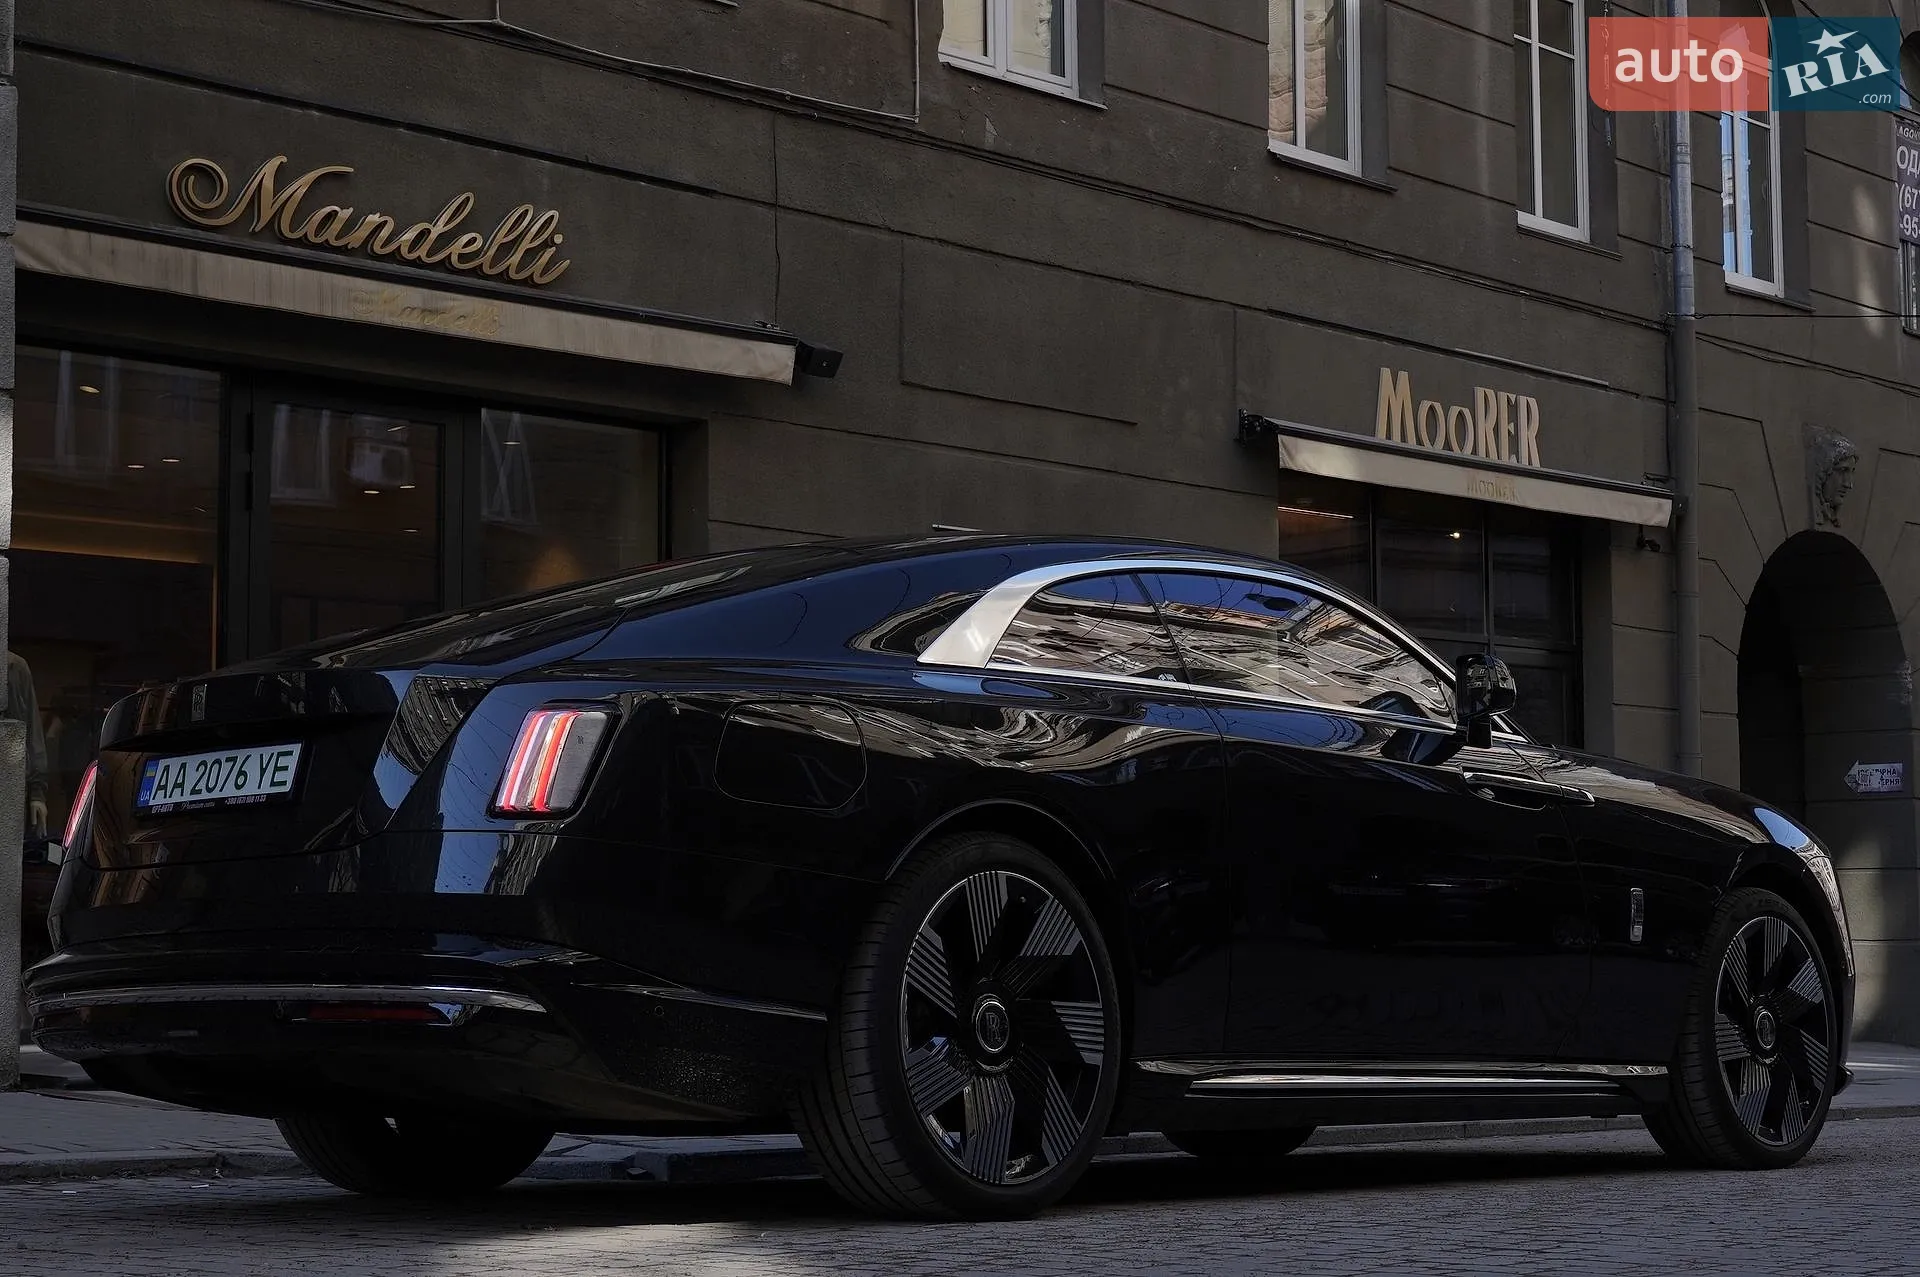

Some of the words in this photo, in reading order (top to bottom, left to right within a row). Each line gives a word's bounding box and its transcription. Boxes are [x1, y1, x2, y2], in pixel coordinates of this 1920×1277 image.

[167, 154, 572, 286] Mandelli
[140, 790, 150, 801] UA
[152, 761, 187, 801] AA
[189, 754, 252, 796] 2076
[257, 750, 294, 789] YE
